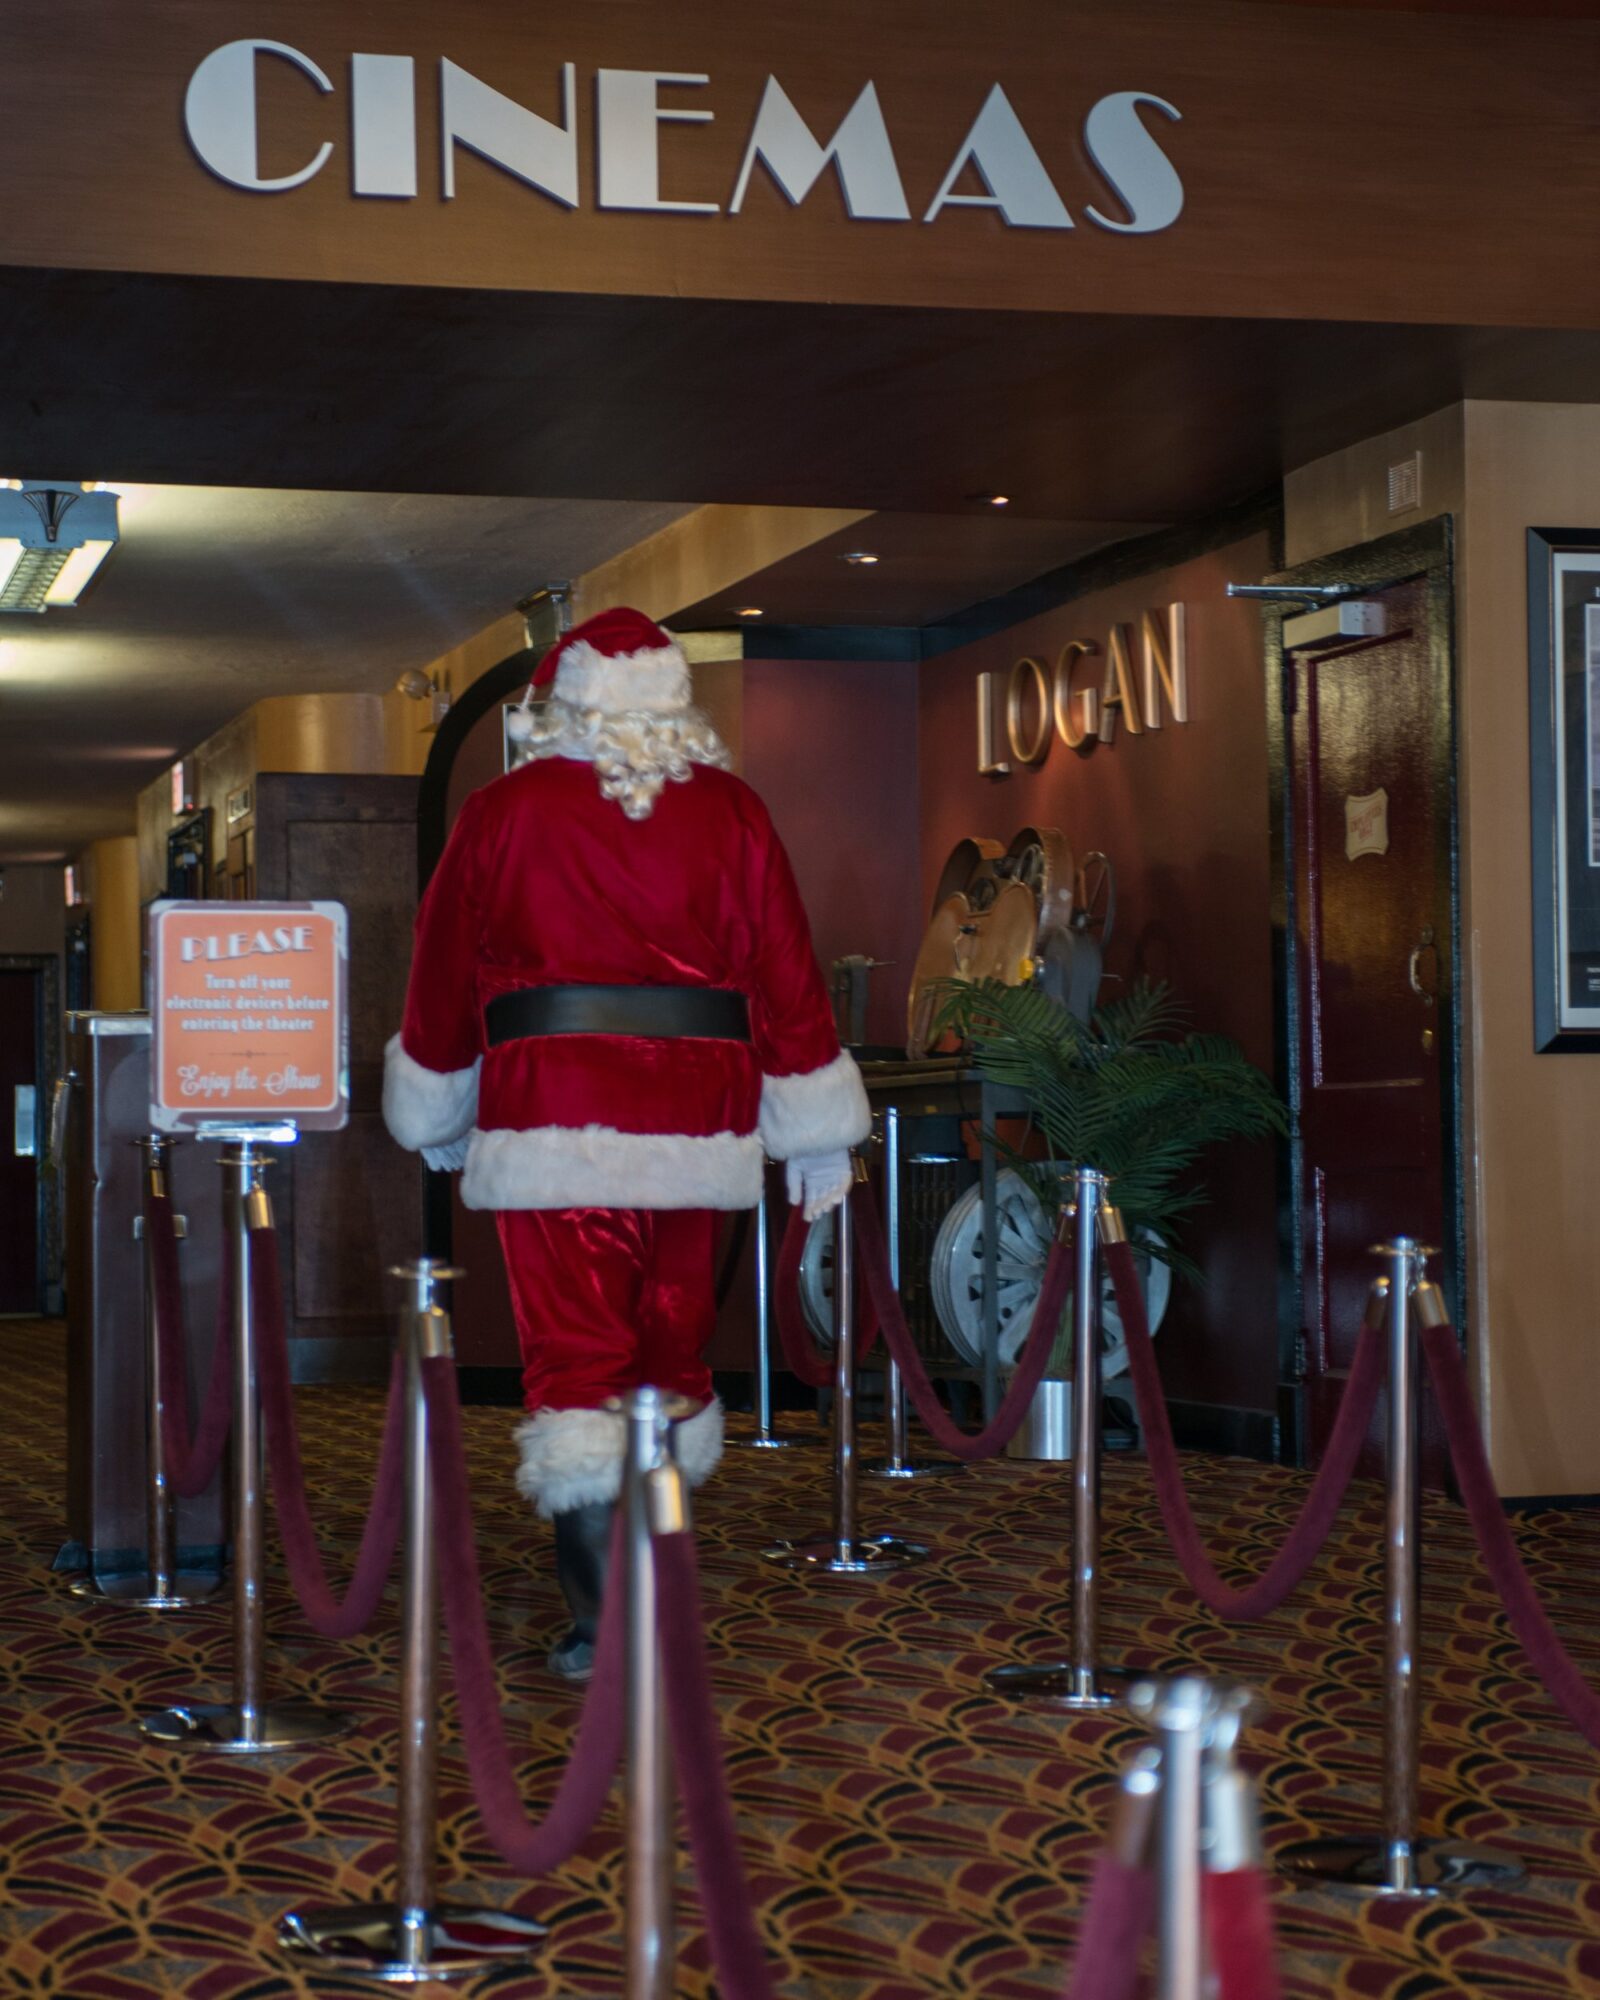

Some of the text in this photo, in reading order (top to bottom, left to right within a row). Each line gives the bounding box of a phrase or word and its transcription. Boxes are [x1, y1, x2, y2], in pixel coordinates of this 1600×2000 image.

[185, 38, 1184, 233] CINEMAS
[976, 602, 1188, 774] LOGAN
[181, 926, 313, 962] PLEASE
[205, 974, 291, 991] Turn off your
[166, 995, 329, 1010] electronic devices before
[181, 1016, 315, 1032] entering the theater
[177, 1064, 322, 1098] Enjoy the Show
